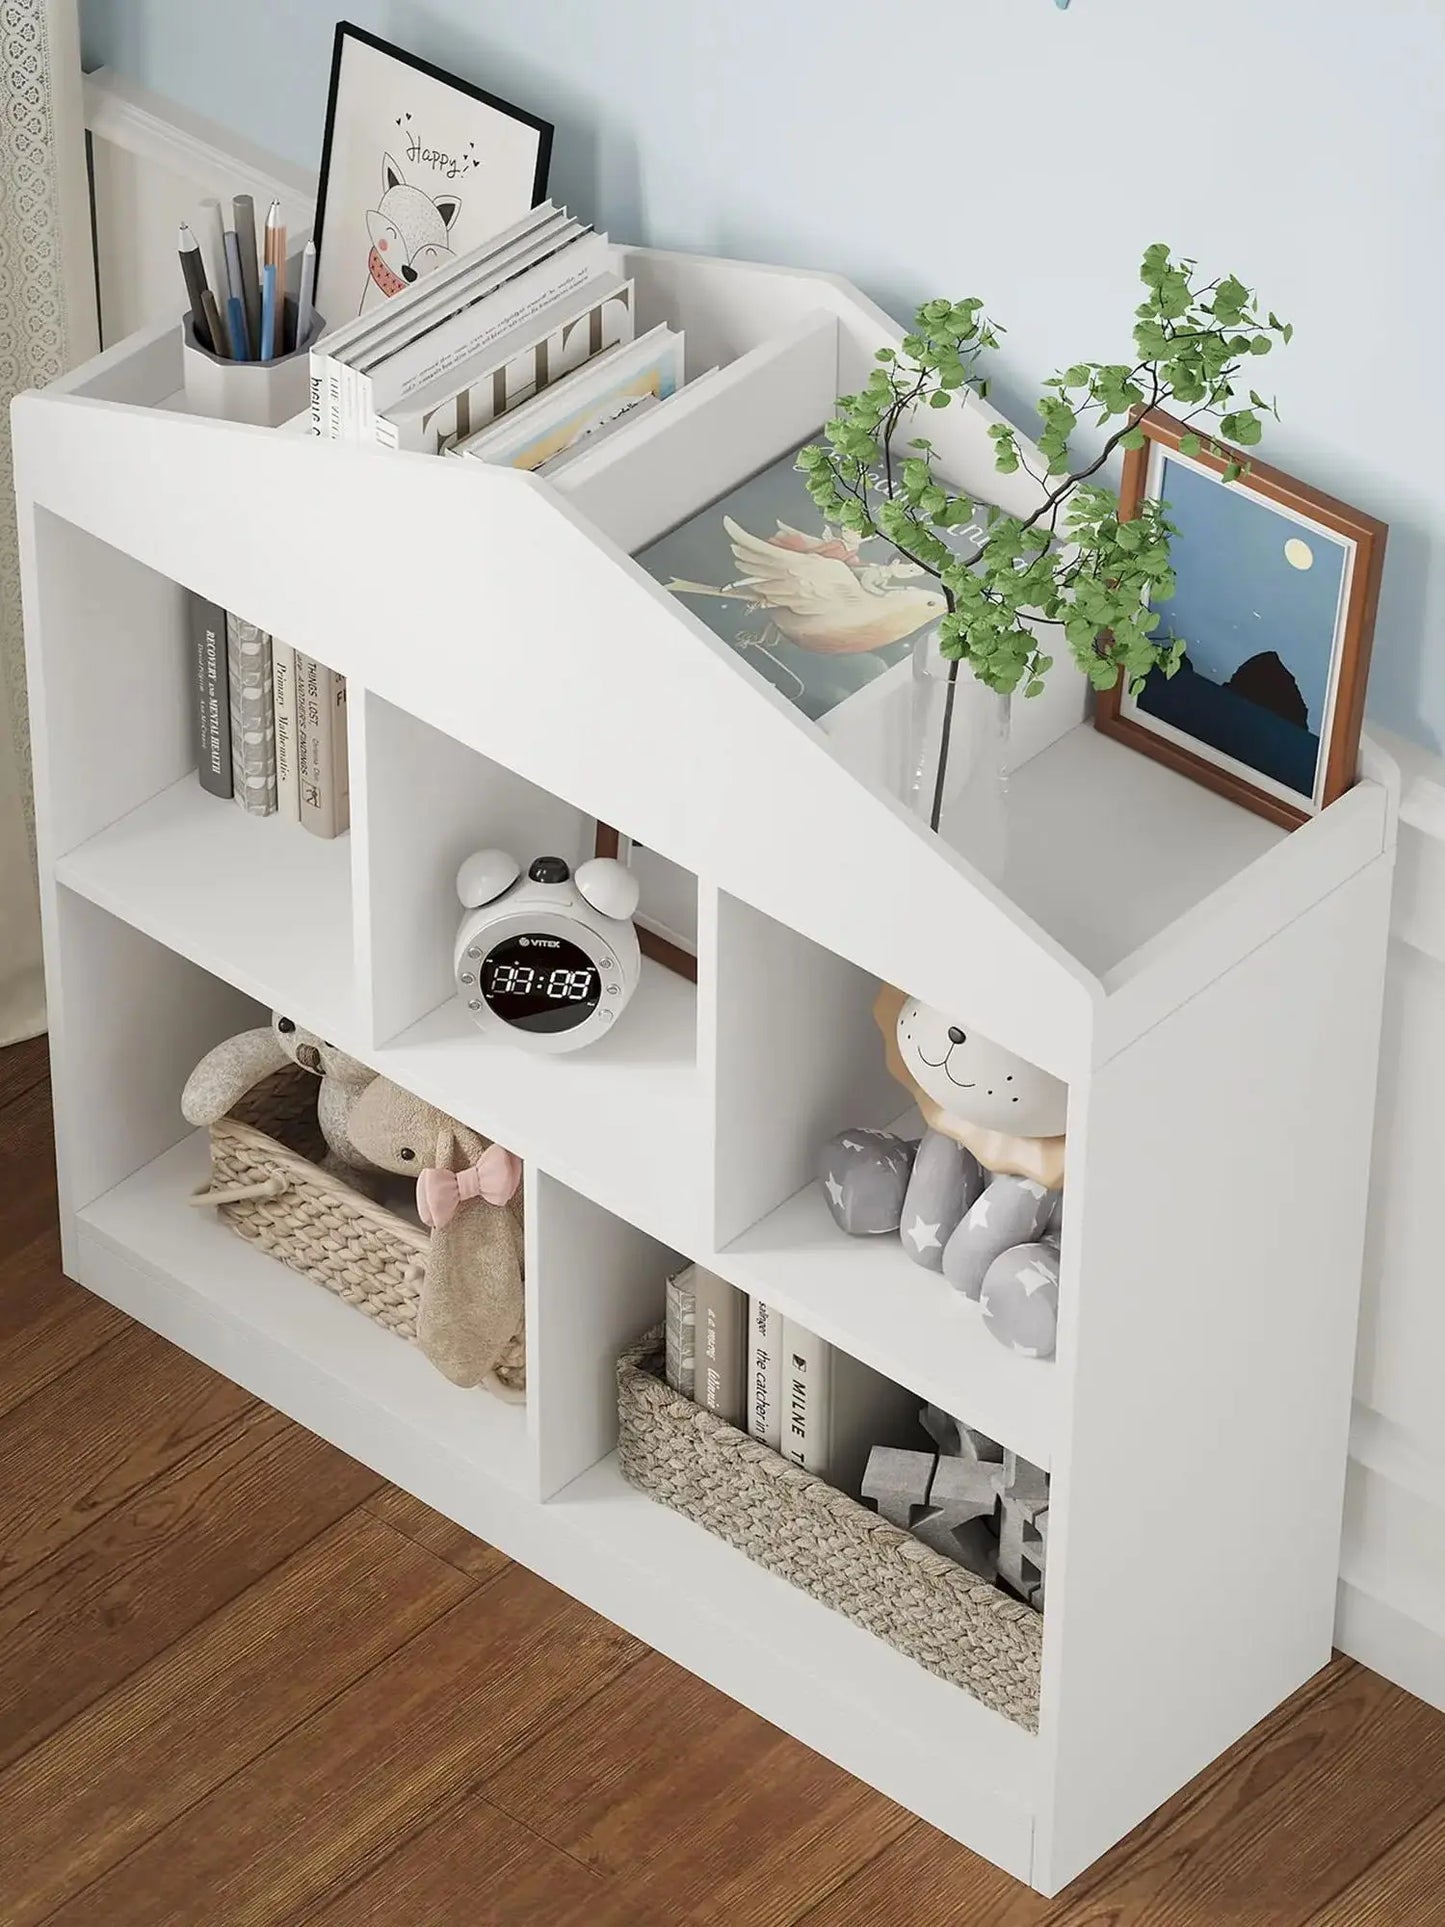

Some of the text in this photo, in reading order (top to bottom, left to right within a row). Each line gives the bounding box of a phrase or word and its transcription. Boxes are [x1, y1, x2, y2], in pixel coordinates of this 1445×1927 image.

[206, 630, 217, 682] RECOVERY
[307, 662, 318, 697] THINGS
[209, 697, 219, 735] MENTAL
[276, 662, 289, 781] Primary Mathematics
[211, 735, 221, 775] HEALTH
[300, 729, 308, 776] FINDINGS
[530, 938, 561, 949] VITEX
[756, 1301, 769, 1337] salinger
[756, 1349, 770, 1370] the
[756, 1372, 770, 1421] catcher
[791, 1379, 806, 1438] MILNE
